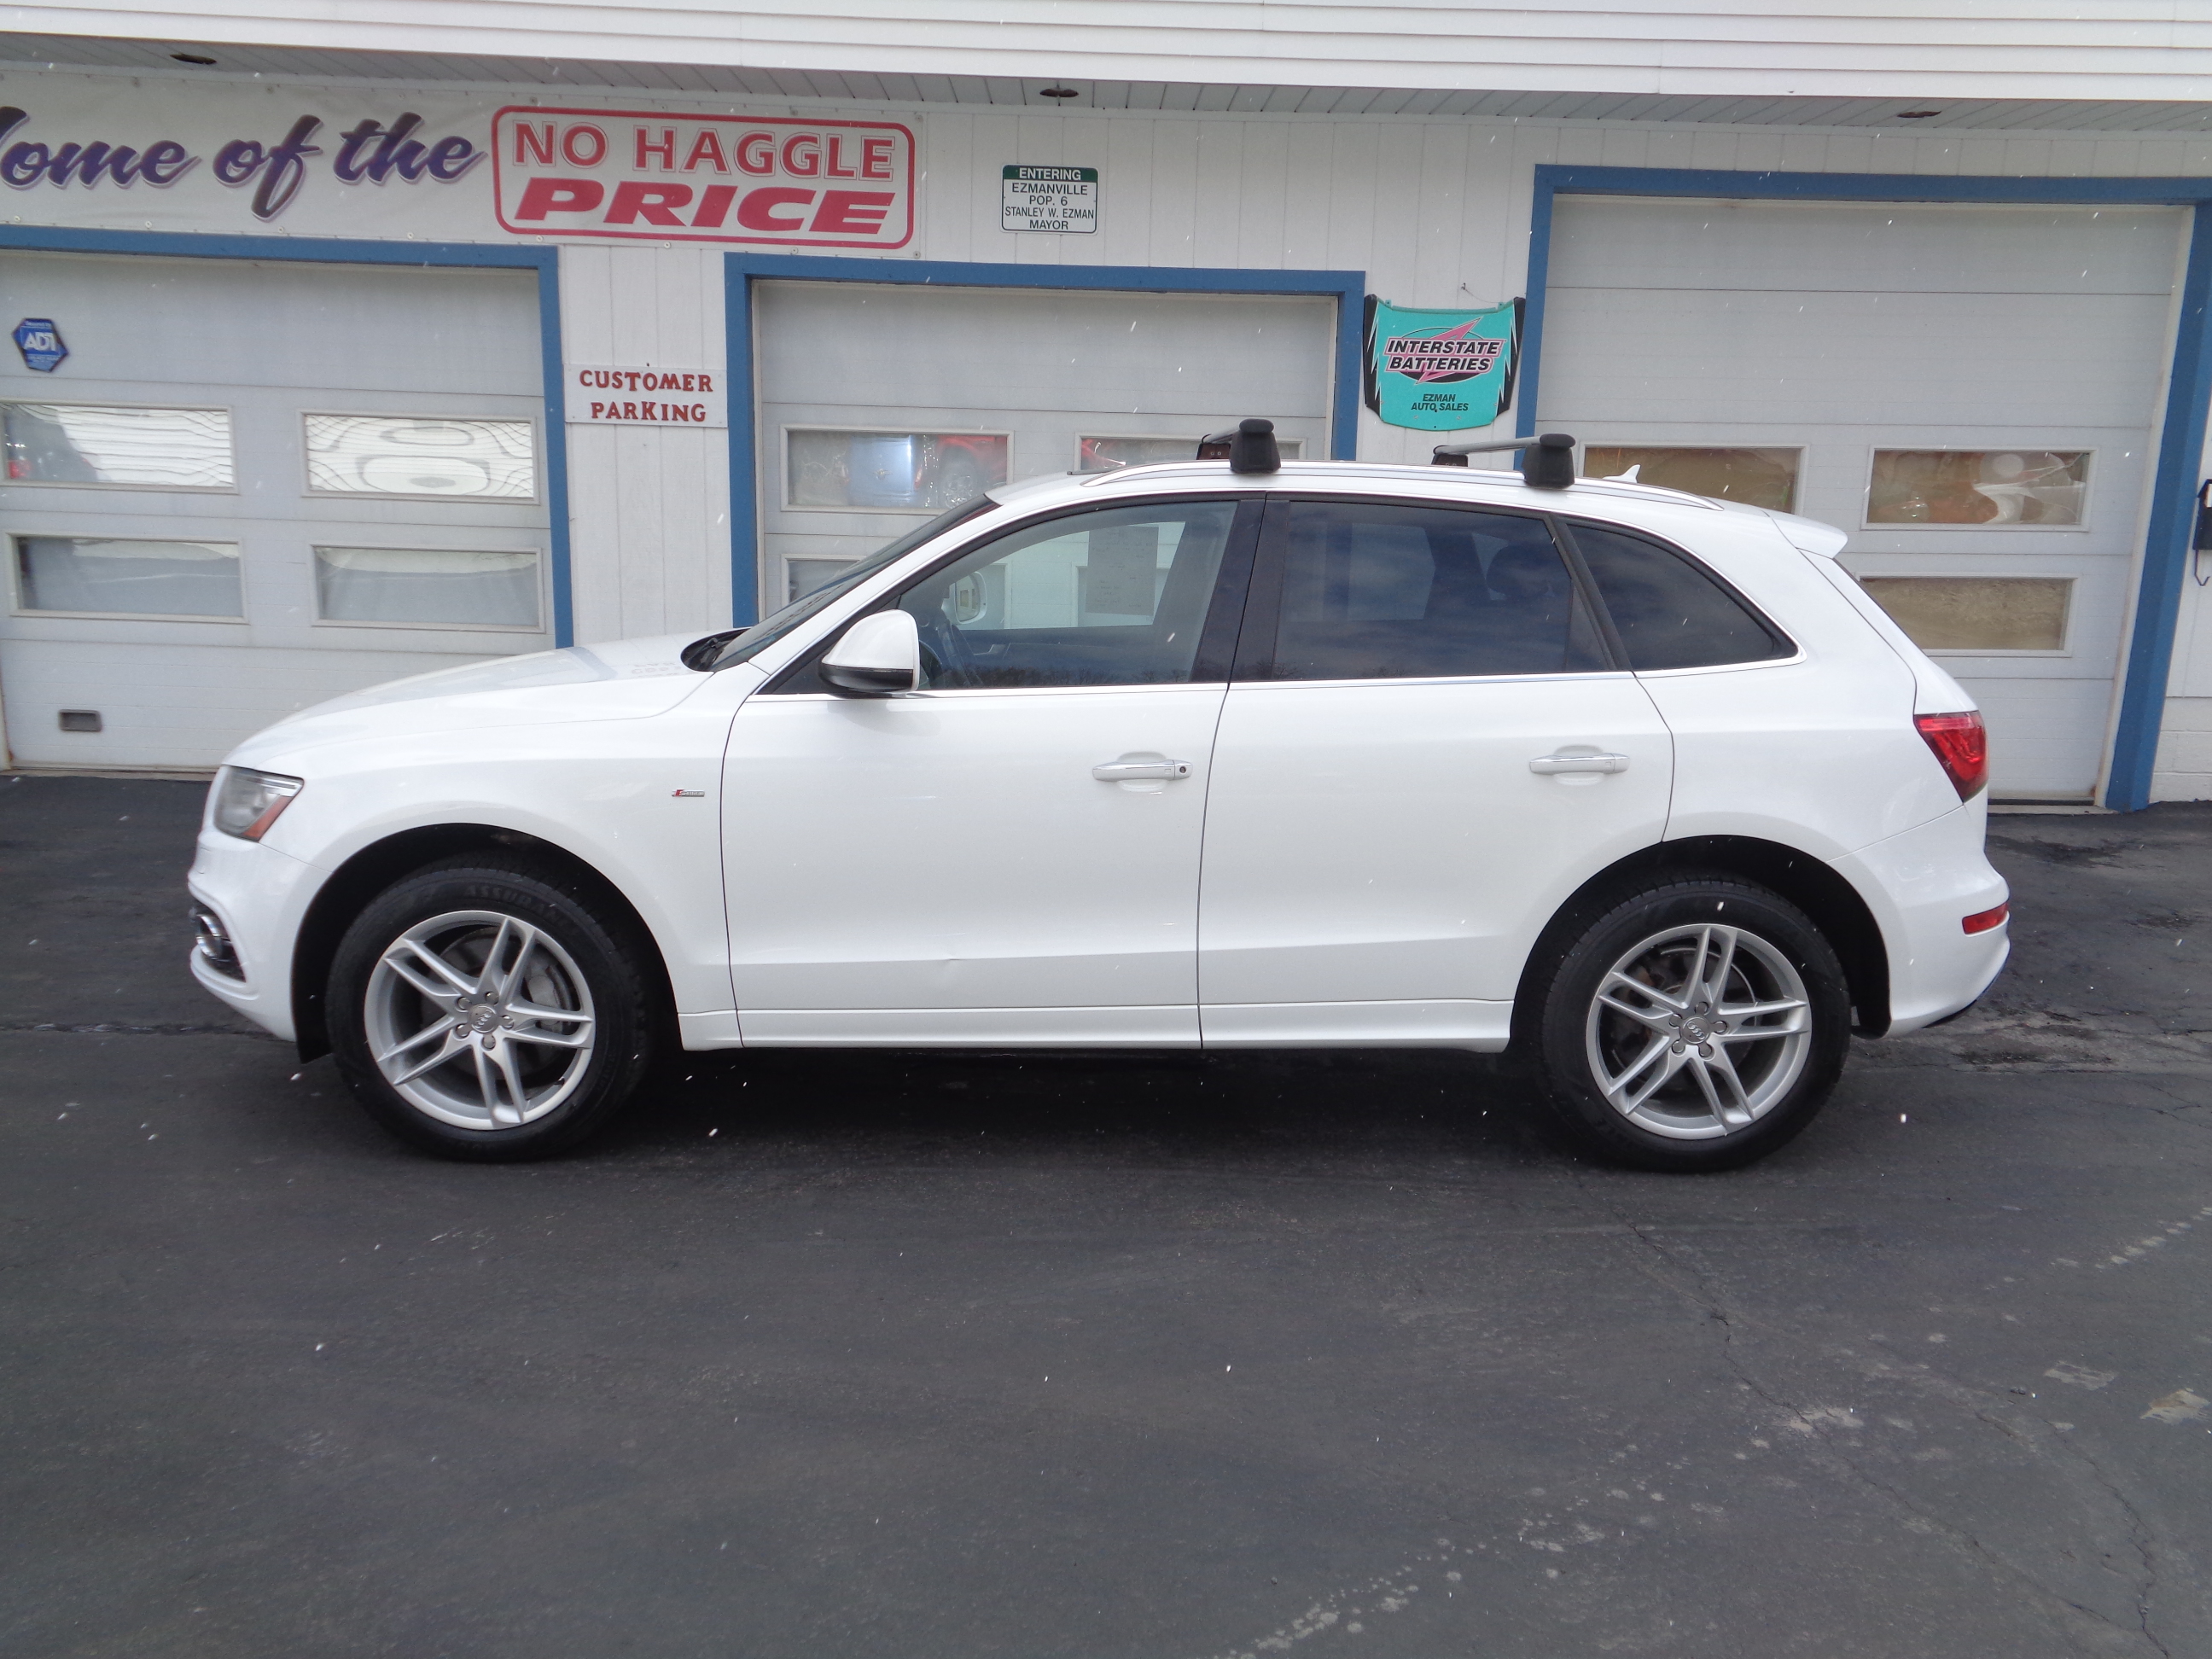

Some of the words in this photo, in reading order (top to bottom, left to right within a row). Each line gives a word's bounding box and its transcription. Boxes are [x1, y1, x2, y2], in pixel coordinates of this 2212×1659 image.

[513, 119, 608, 169] NO
[632, 125, 896, 182] HAGGLE
[212, 114, 323, 221] of
[335, 112, 488, 186] the
[1019, 167, 1081, 181] ENTERING
[1012, 183, 1088, 195] EZMANVILLE
[514, 177, 896, 235] PRICE
[1029, 195, 1055, 206] POP.
[1061, 195, 1068, 206] 6
[1005, 207, 1045, 217] STANLEY
[1048, 207, 1059, 218] W.
[1062, 208, 1094, 219] EZMAN
[1029, 219, 1068, 230] MAYOR
[24, 332, 56, 352] ADT
[1388, 340, 1500, 354] INTERSTATE
[1389, 357, 1491, 370] BATTERIES
[579, 370, 713, 393] CUSTOMER
[1423, 393, 1456, 402] EZMAN
[591, 401, 707, 422] PARKING
[1411, 403, 1436, 411] AUTO
[1439, 403, 1469, 411] SALES
